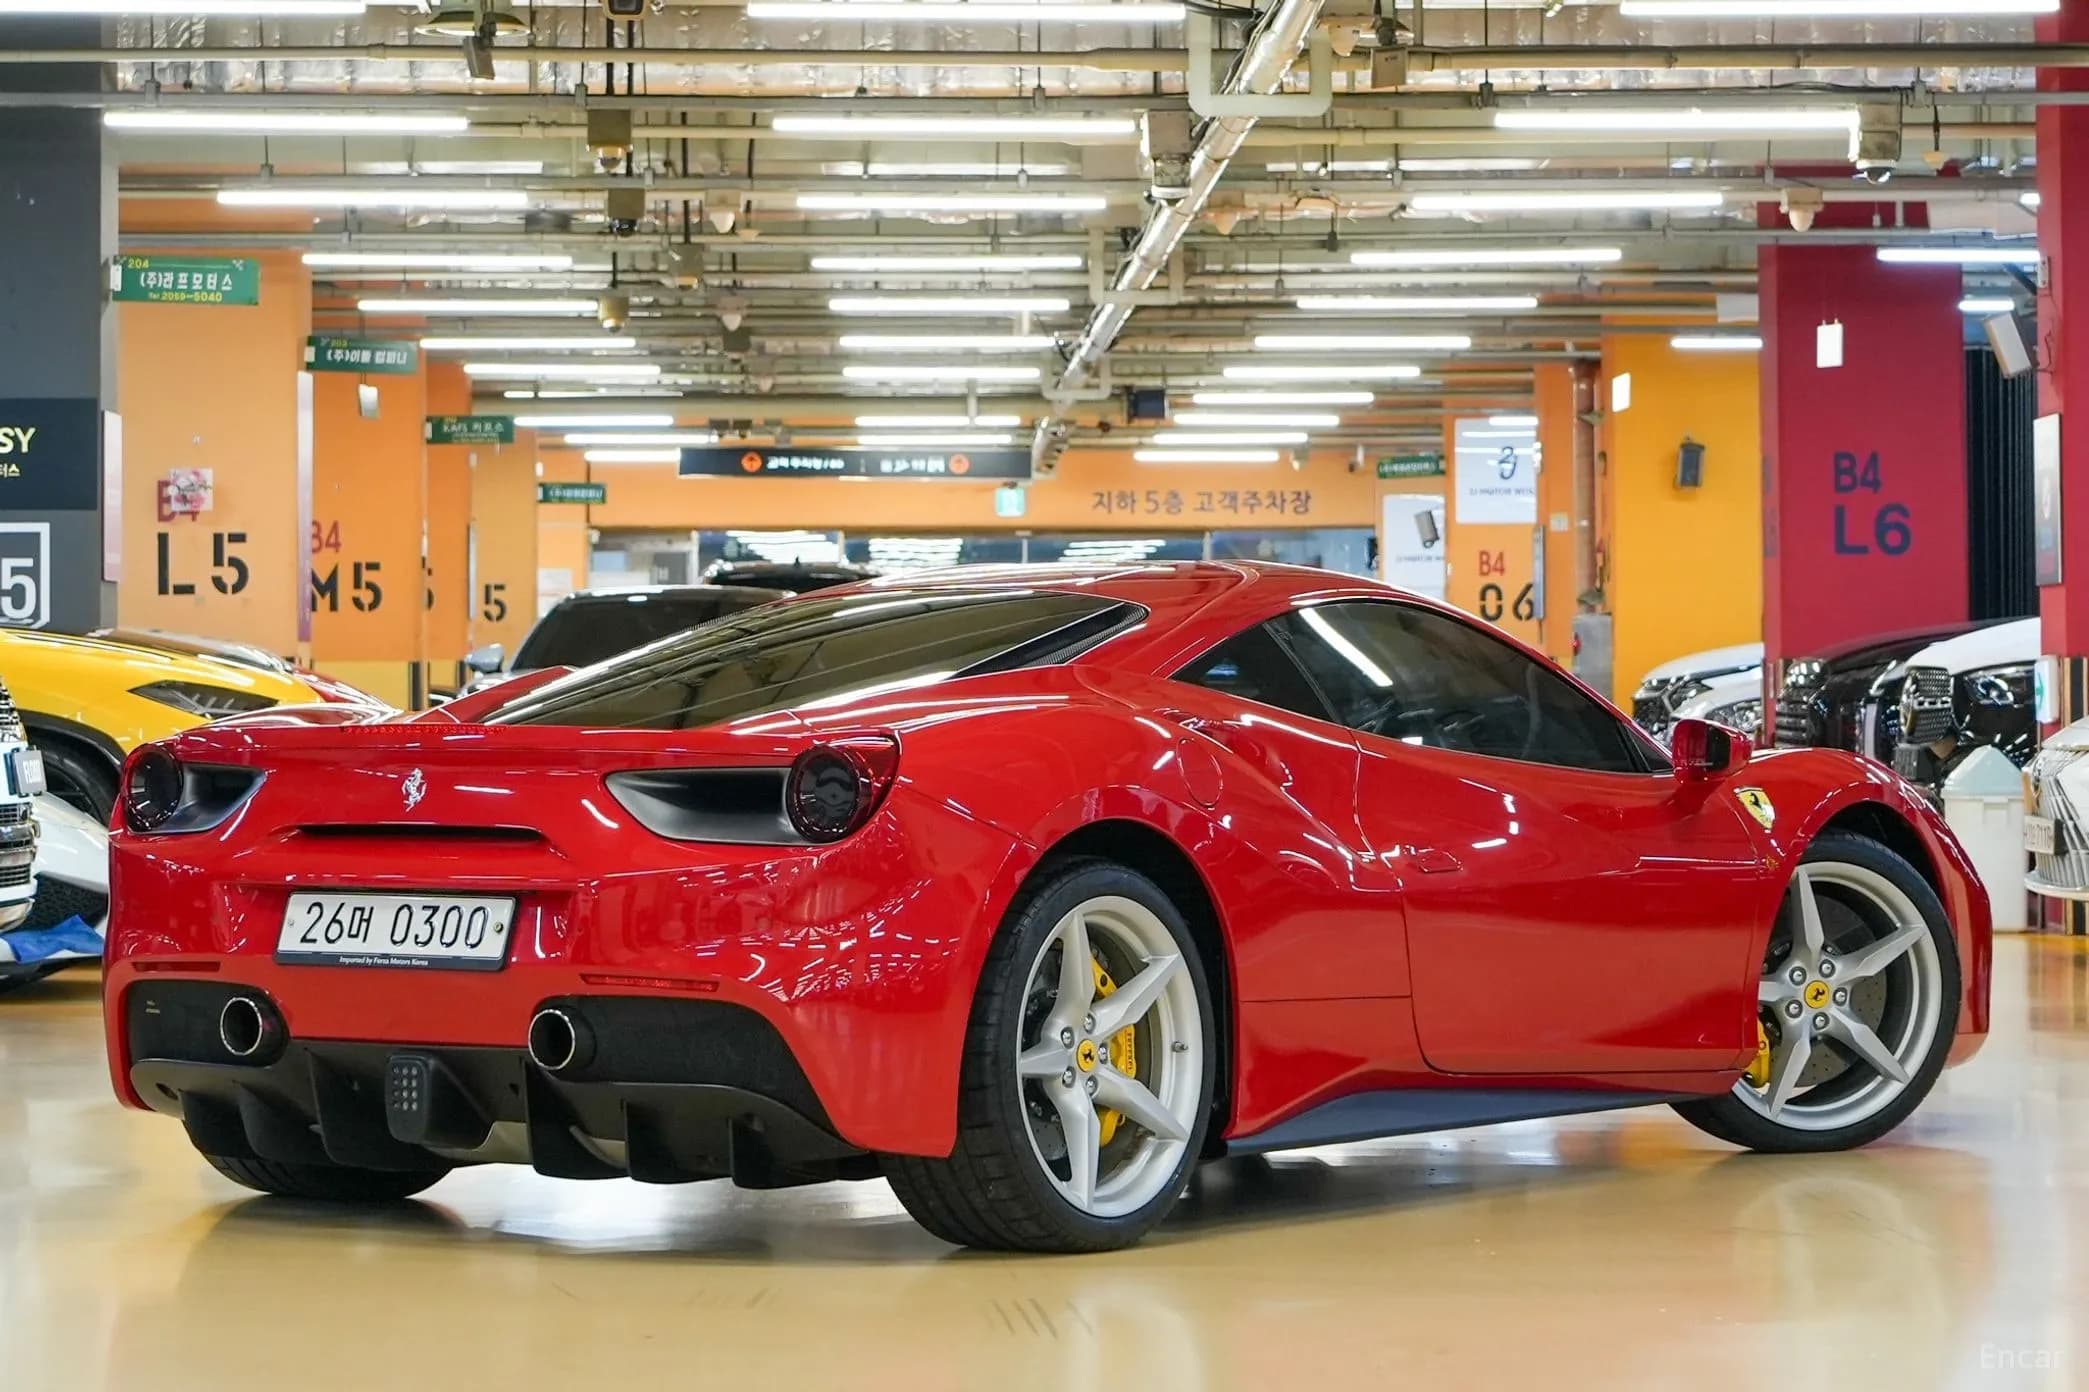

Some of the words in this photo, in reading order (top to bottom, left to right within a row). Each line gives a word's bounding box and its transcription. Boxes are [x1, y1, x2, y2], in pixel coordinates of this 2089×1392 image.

[1835, 451, 1881, 494] B4
[1093, 491, 1136, 514] 지하
[1145, 491, 1184, 514] 5층
[1194, 490, 1313, 515] 고객주차장
[1835, 502, 1912, 557] L6
[157, 532, 249, 595] L5
[311, 562, 383, 612] M5
[1478, 550, 1506, 577] B4
[1, 557, 37, 620] 5
[483, 584, 507, 622] 5
[300, 901, 375, 945] 26머
[390, 903, 490, 949] 0300
